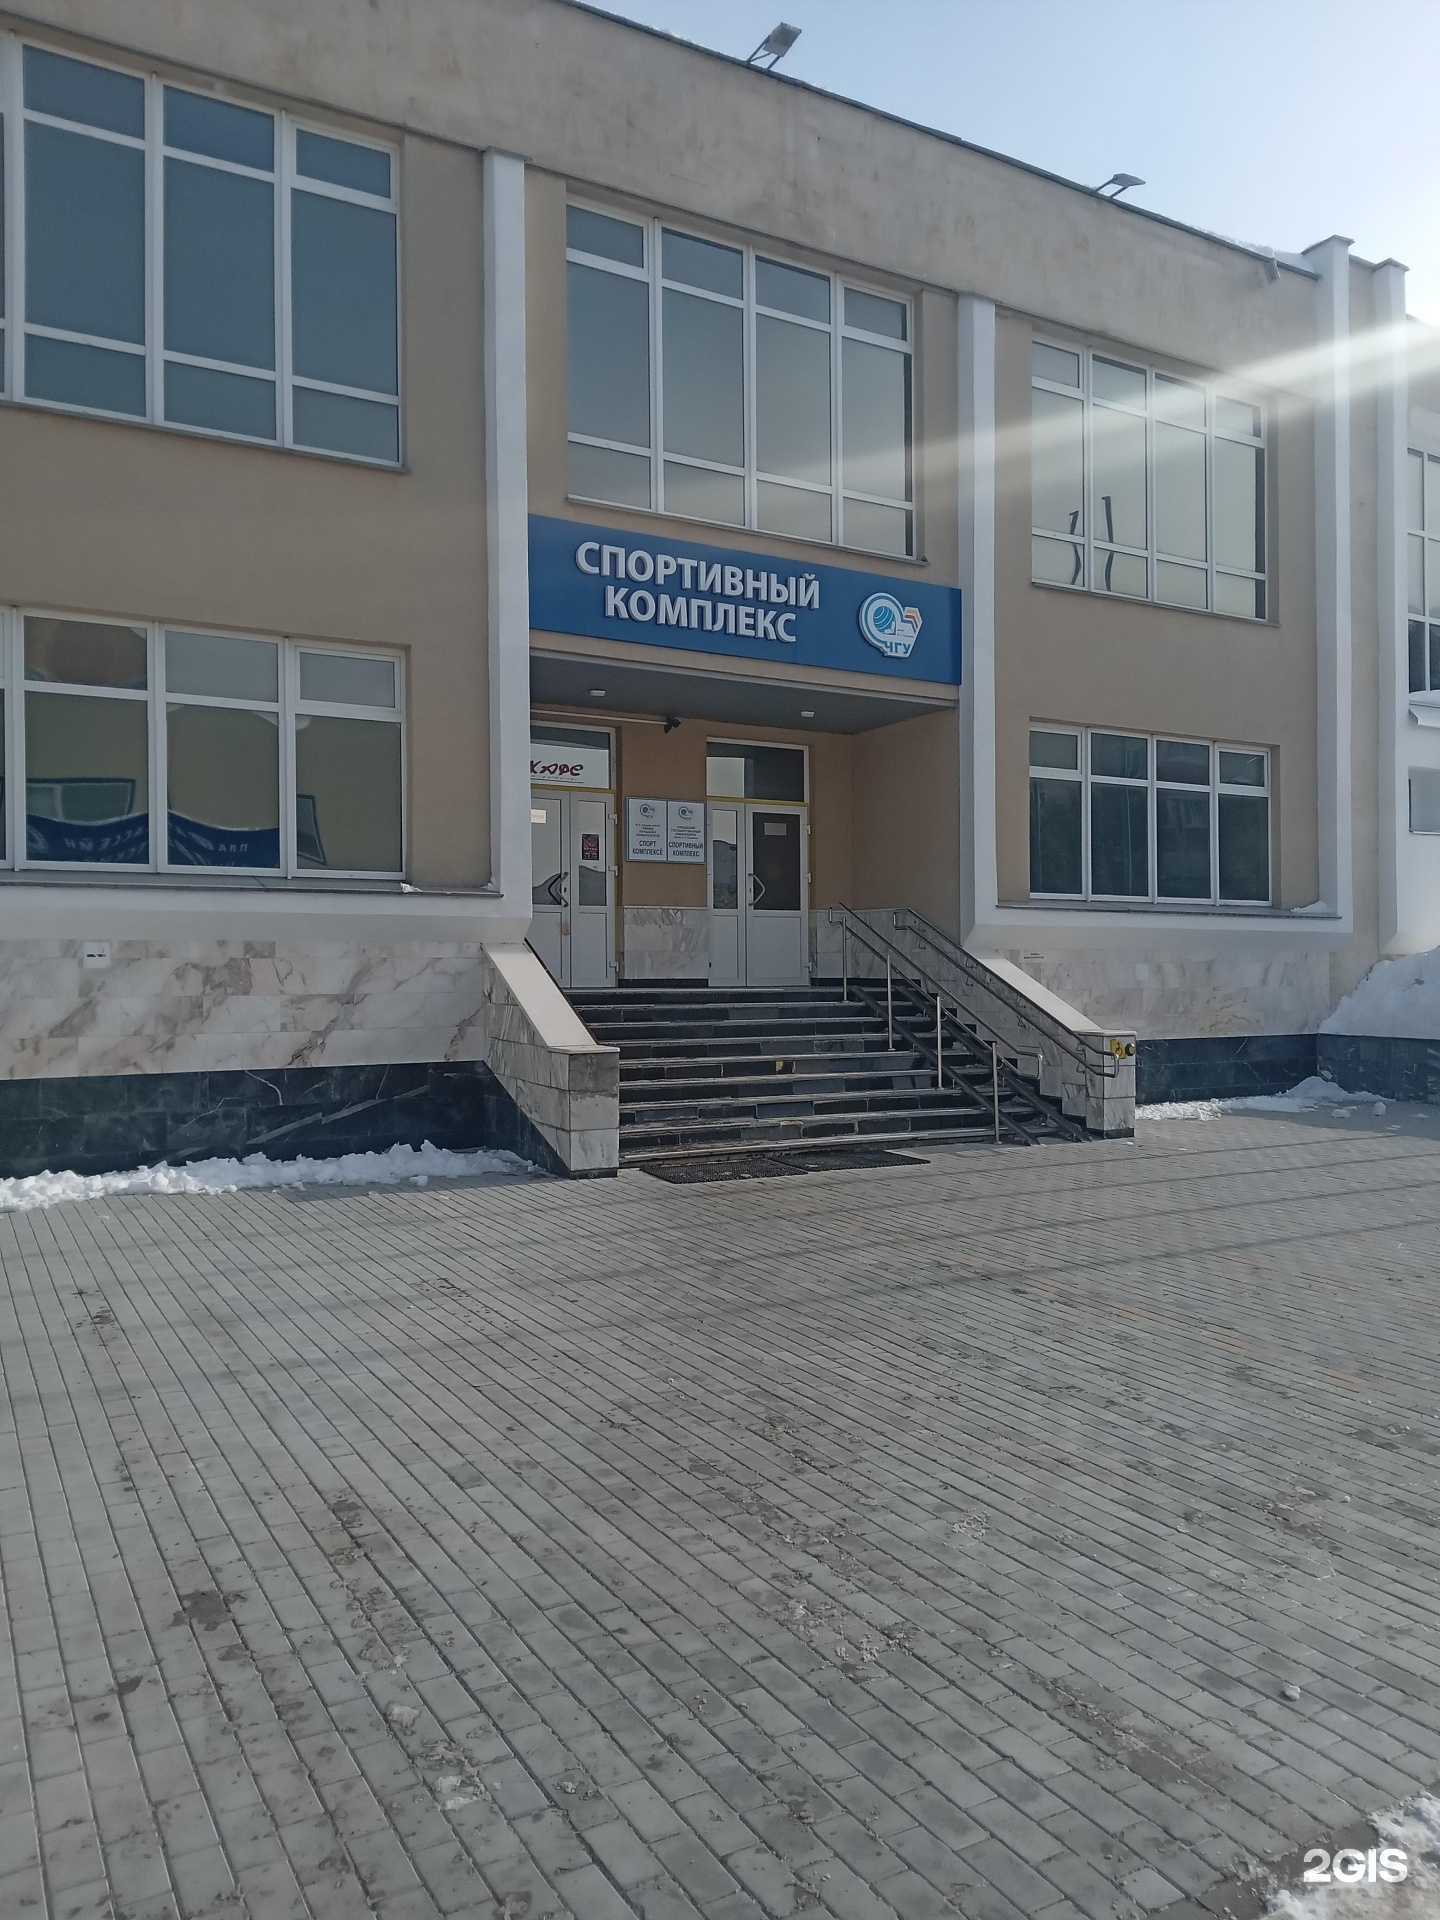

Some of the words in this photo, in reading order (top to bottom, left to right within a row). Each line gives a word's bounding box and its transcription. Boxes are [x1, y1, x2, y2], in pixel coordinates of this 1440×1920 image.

[575, 541, 820, 609] СПОРТИВНЫЙ
[604, 585, 798, 643] КОМПЛЕКС
[884, 641, 912, 655] ЧГУ
